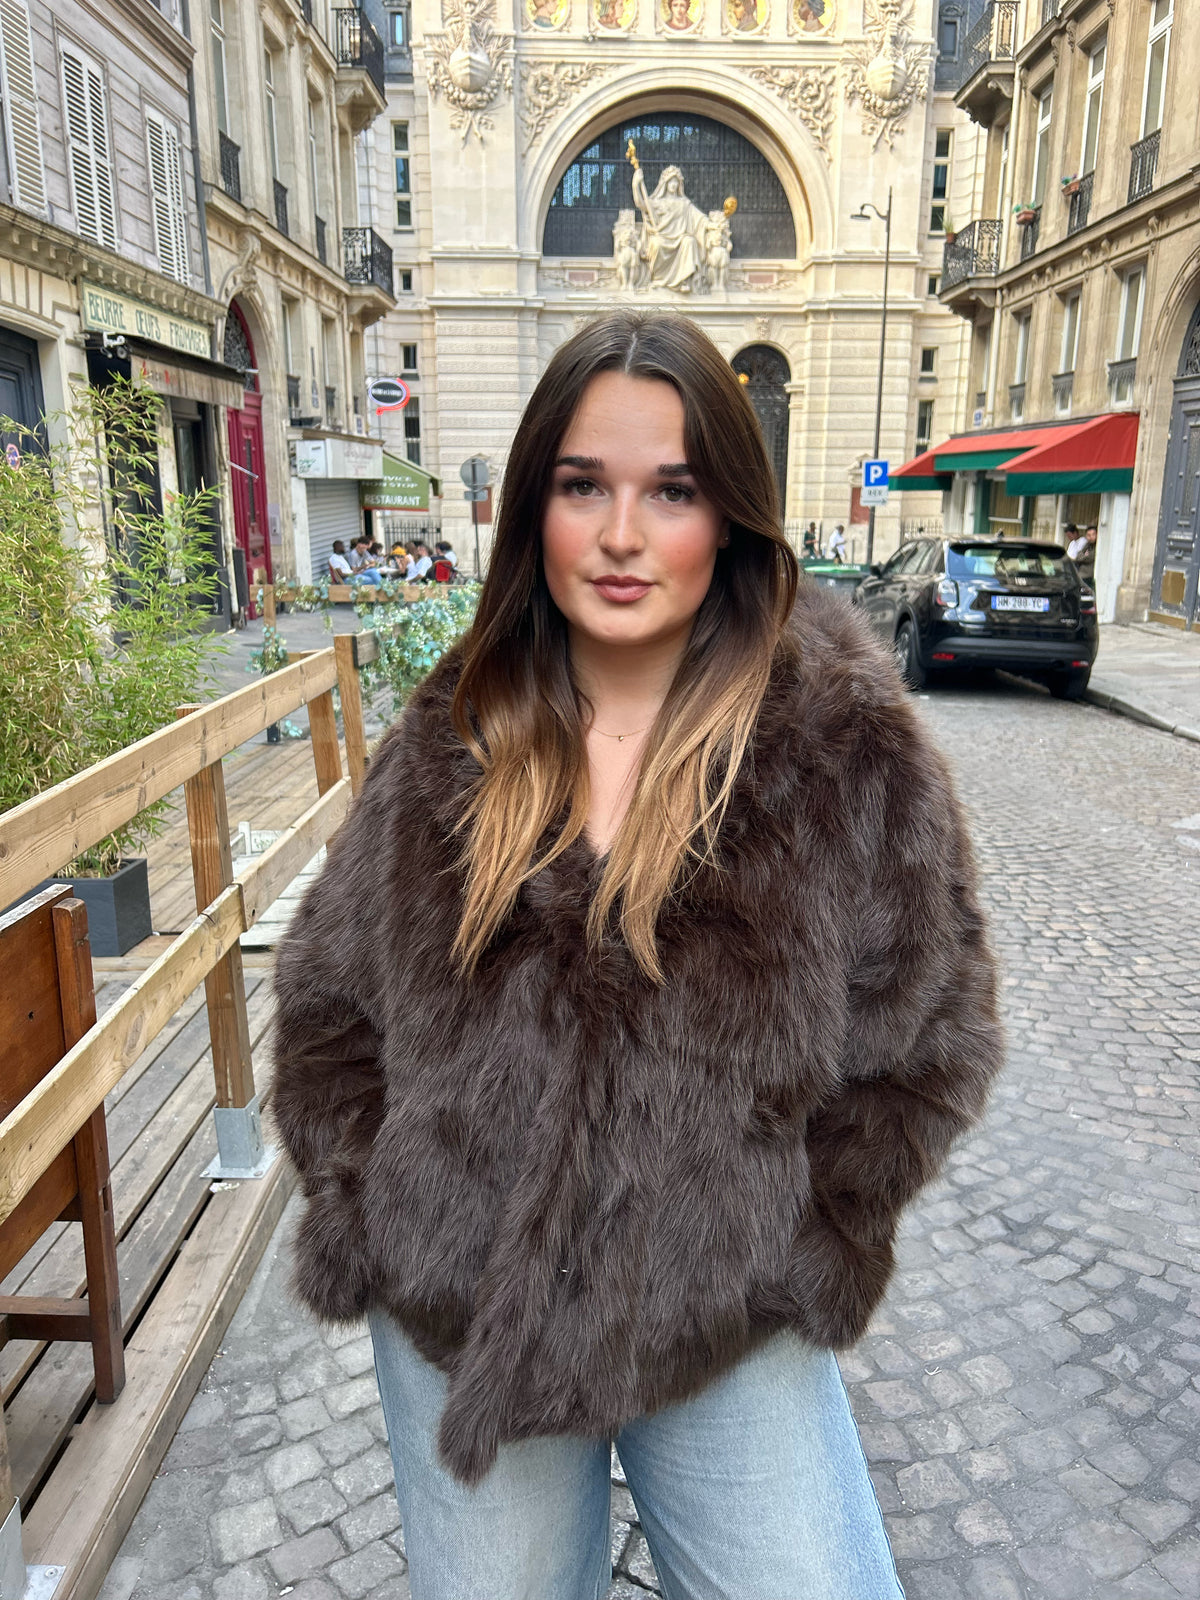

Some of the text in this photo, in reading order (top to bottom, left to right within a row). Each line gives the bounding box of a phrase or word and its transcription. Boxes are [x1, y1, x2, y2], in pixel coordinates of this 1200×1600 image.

[87, 291, 208, 356] BEURRE ŒUFS FROMAGES
[870, 465, 883, 484] P
[364, 494, 421, 506] RESTAURANT
